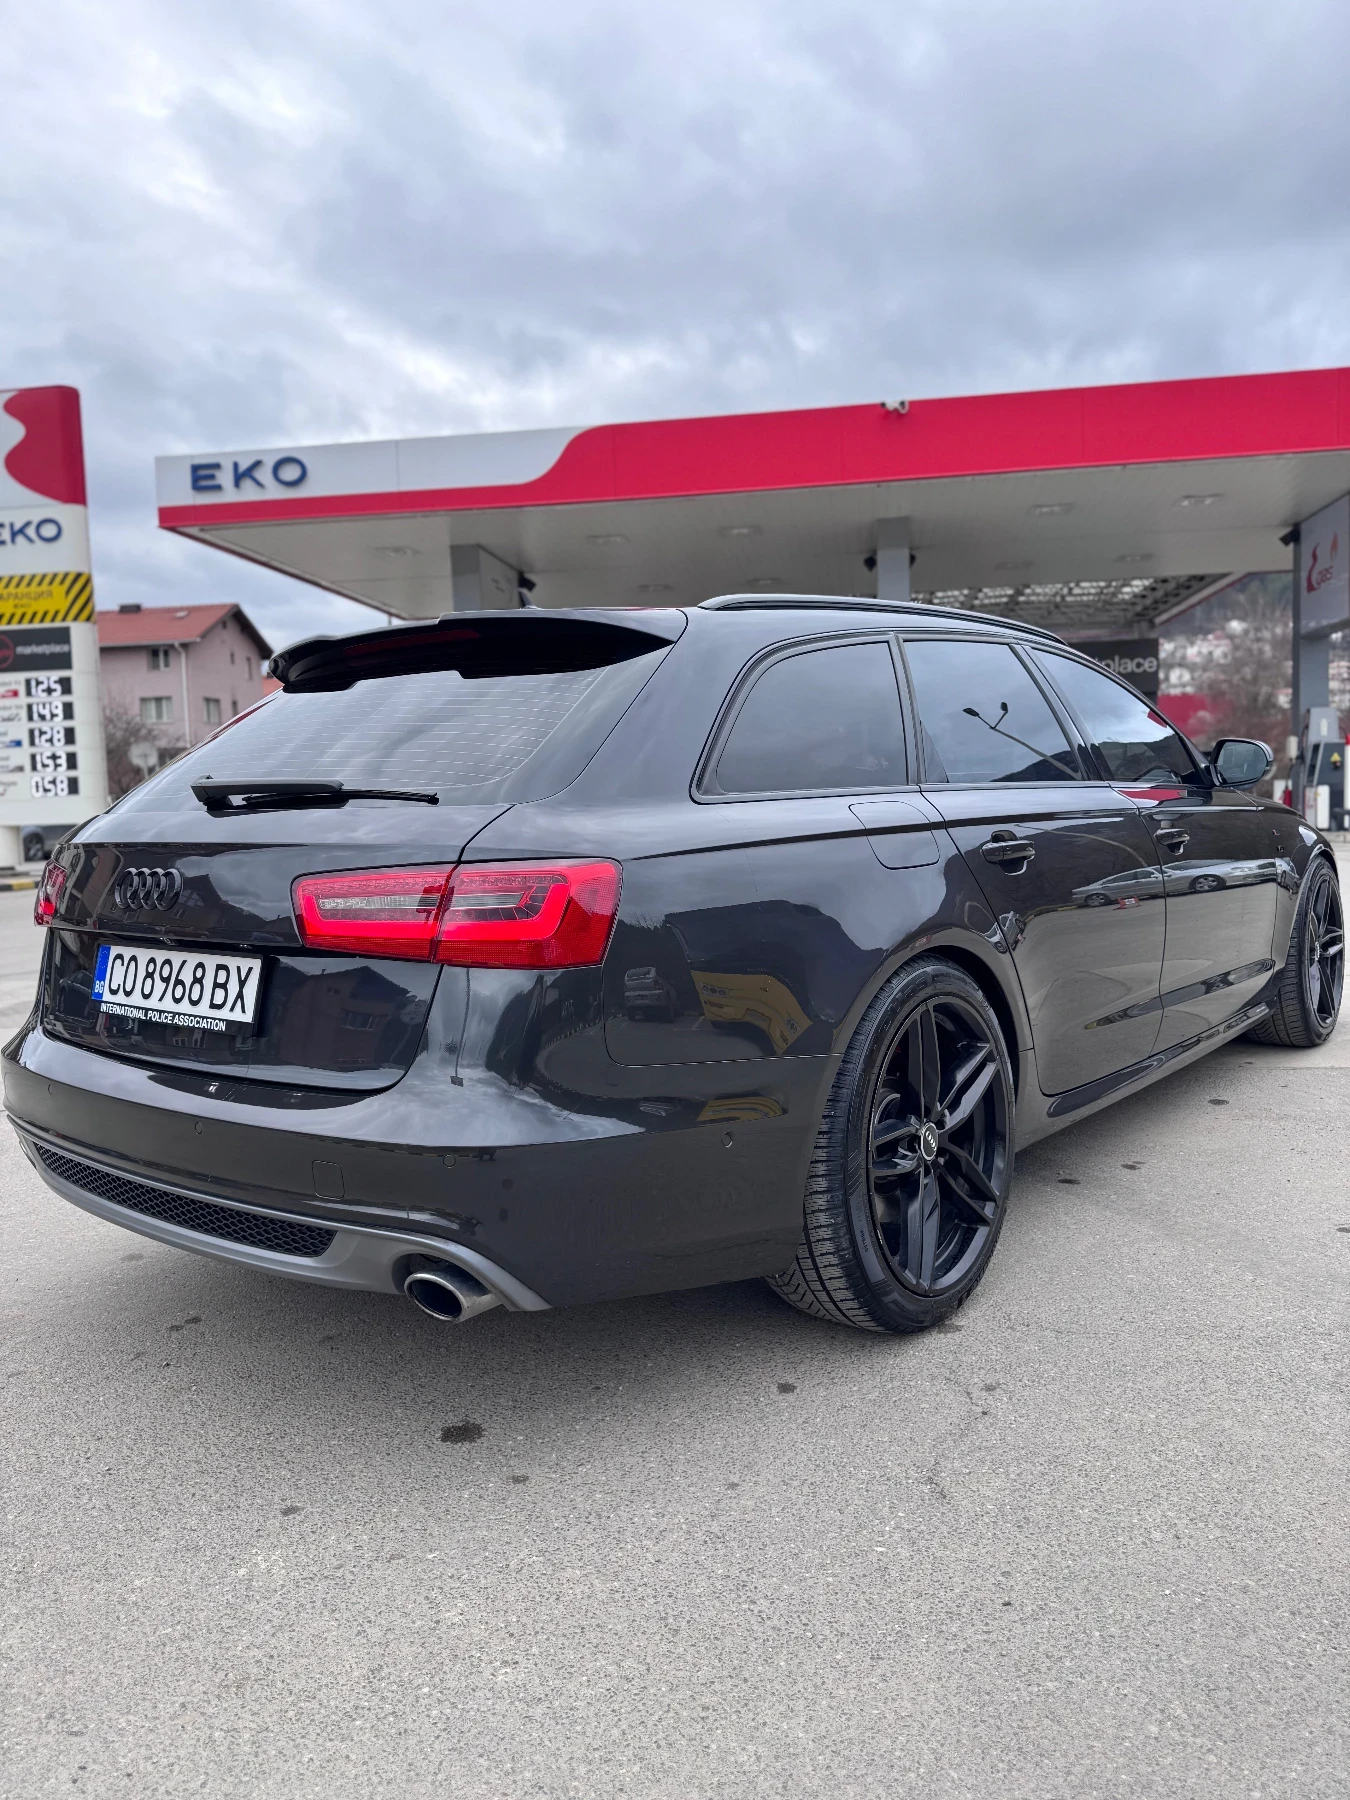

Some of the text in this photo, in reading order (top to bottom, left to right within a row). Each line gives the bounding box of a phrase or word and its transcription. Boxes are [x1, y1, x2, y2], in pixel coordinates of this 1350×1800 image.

[190, 456, 308, 490] EKO
[0, 518, 63, 546] KO
[94, 980, 105, 993] BG
[100, 1002, 226, 1032] INTERNATIONAL POLICE ASSOCIATION
